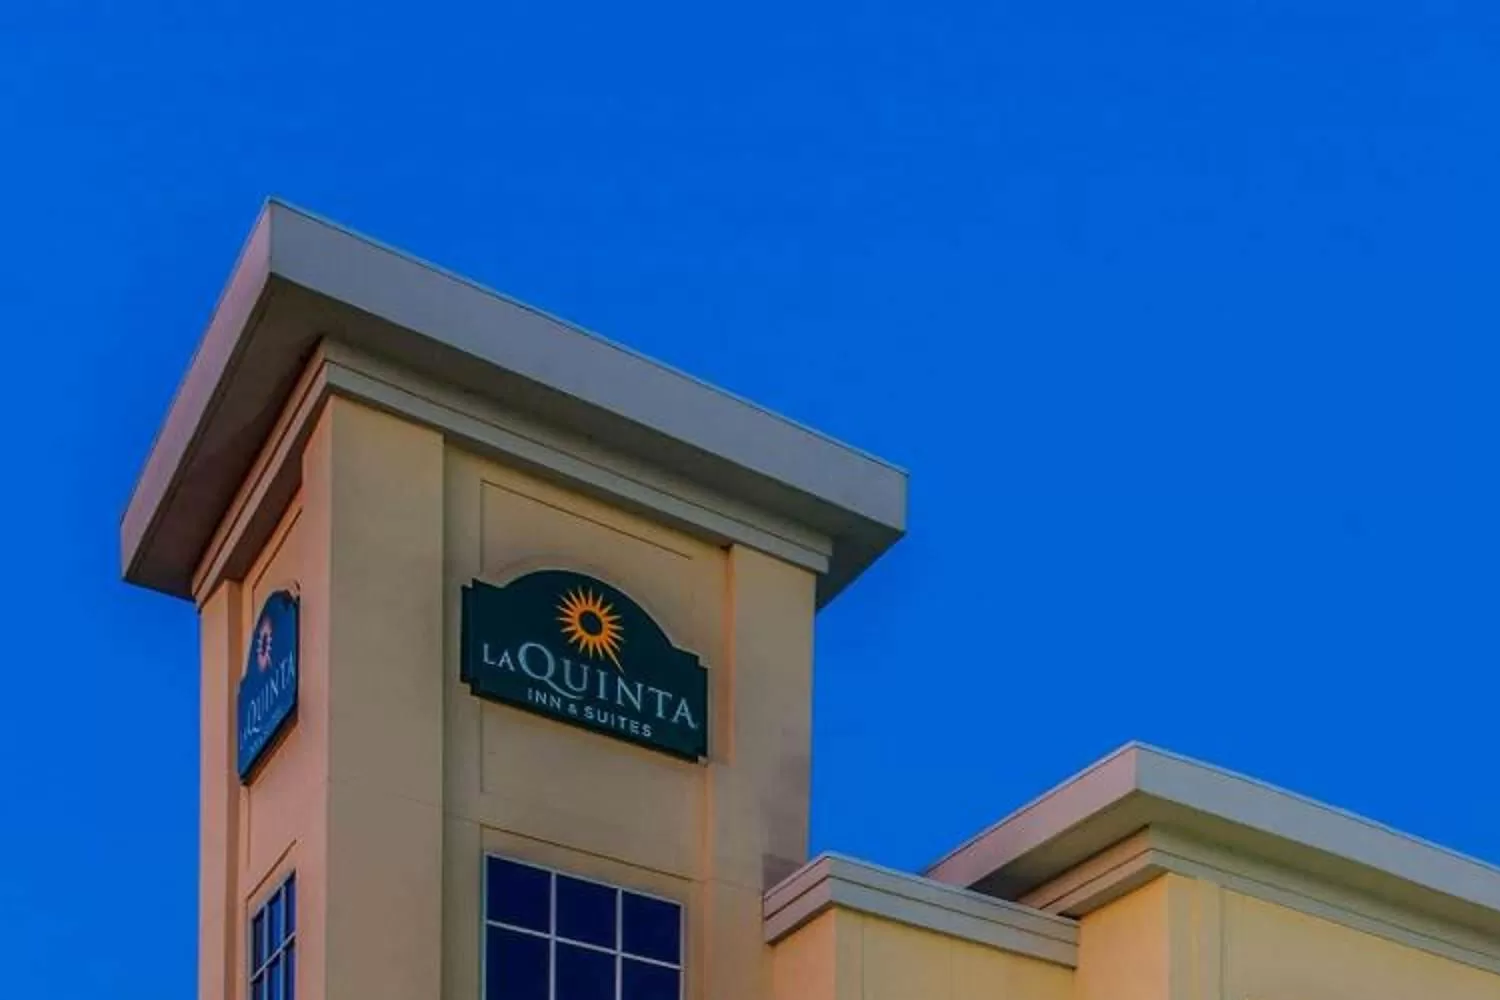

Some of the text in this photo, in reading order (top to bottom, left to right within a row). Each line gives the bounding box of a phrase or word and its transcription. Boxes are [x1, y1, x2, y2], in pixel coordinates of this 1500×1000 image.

[517, 642, 699, 729] QUINTA
[527, 687, 653, 738] INN & SUITES
